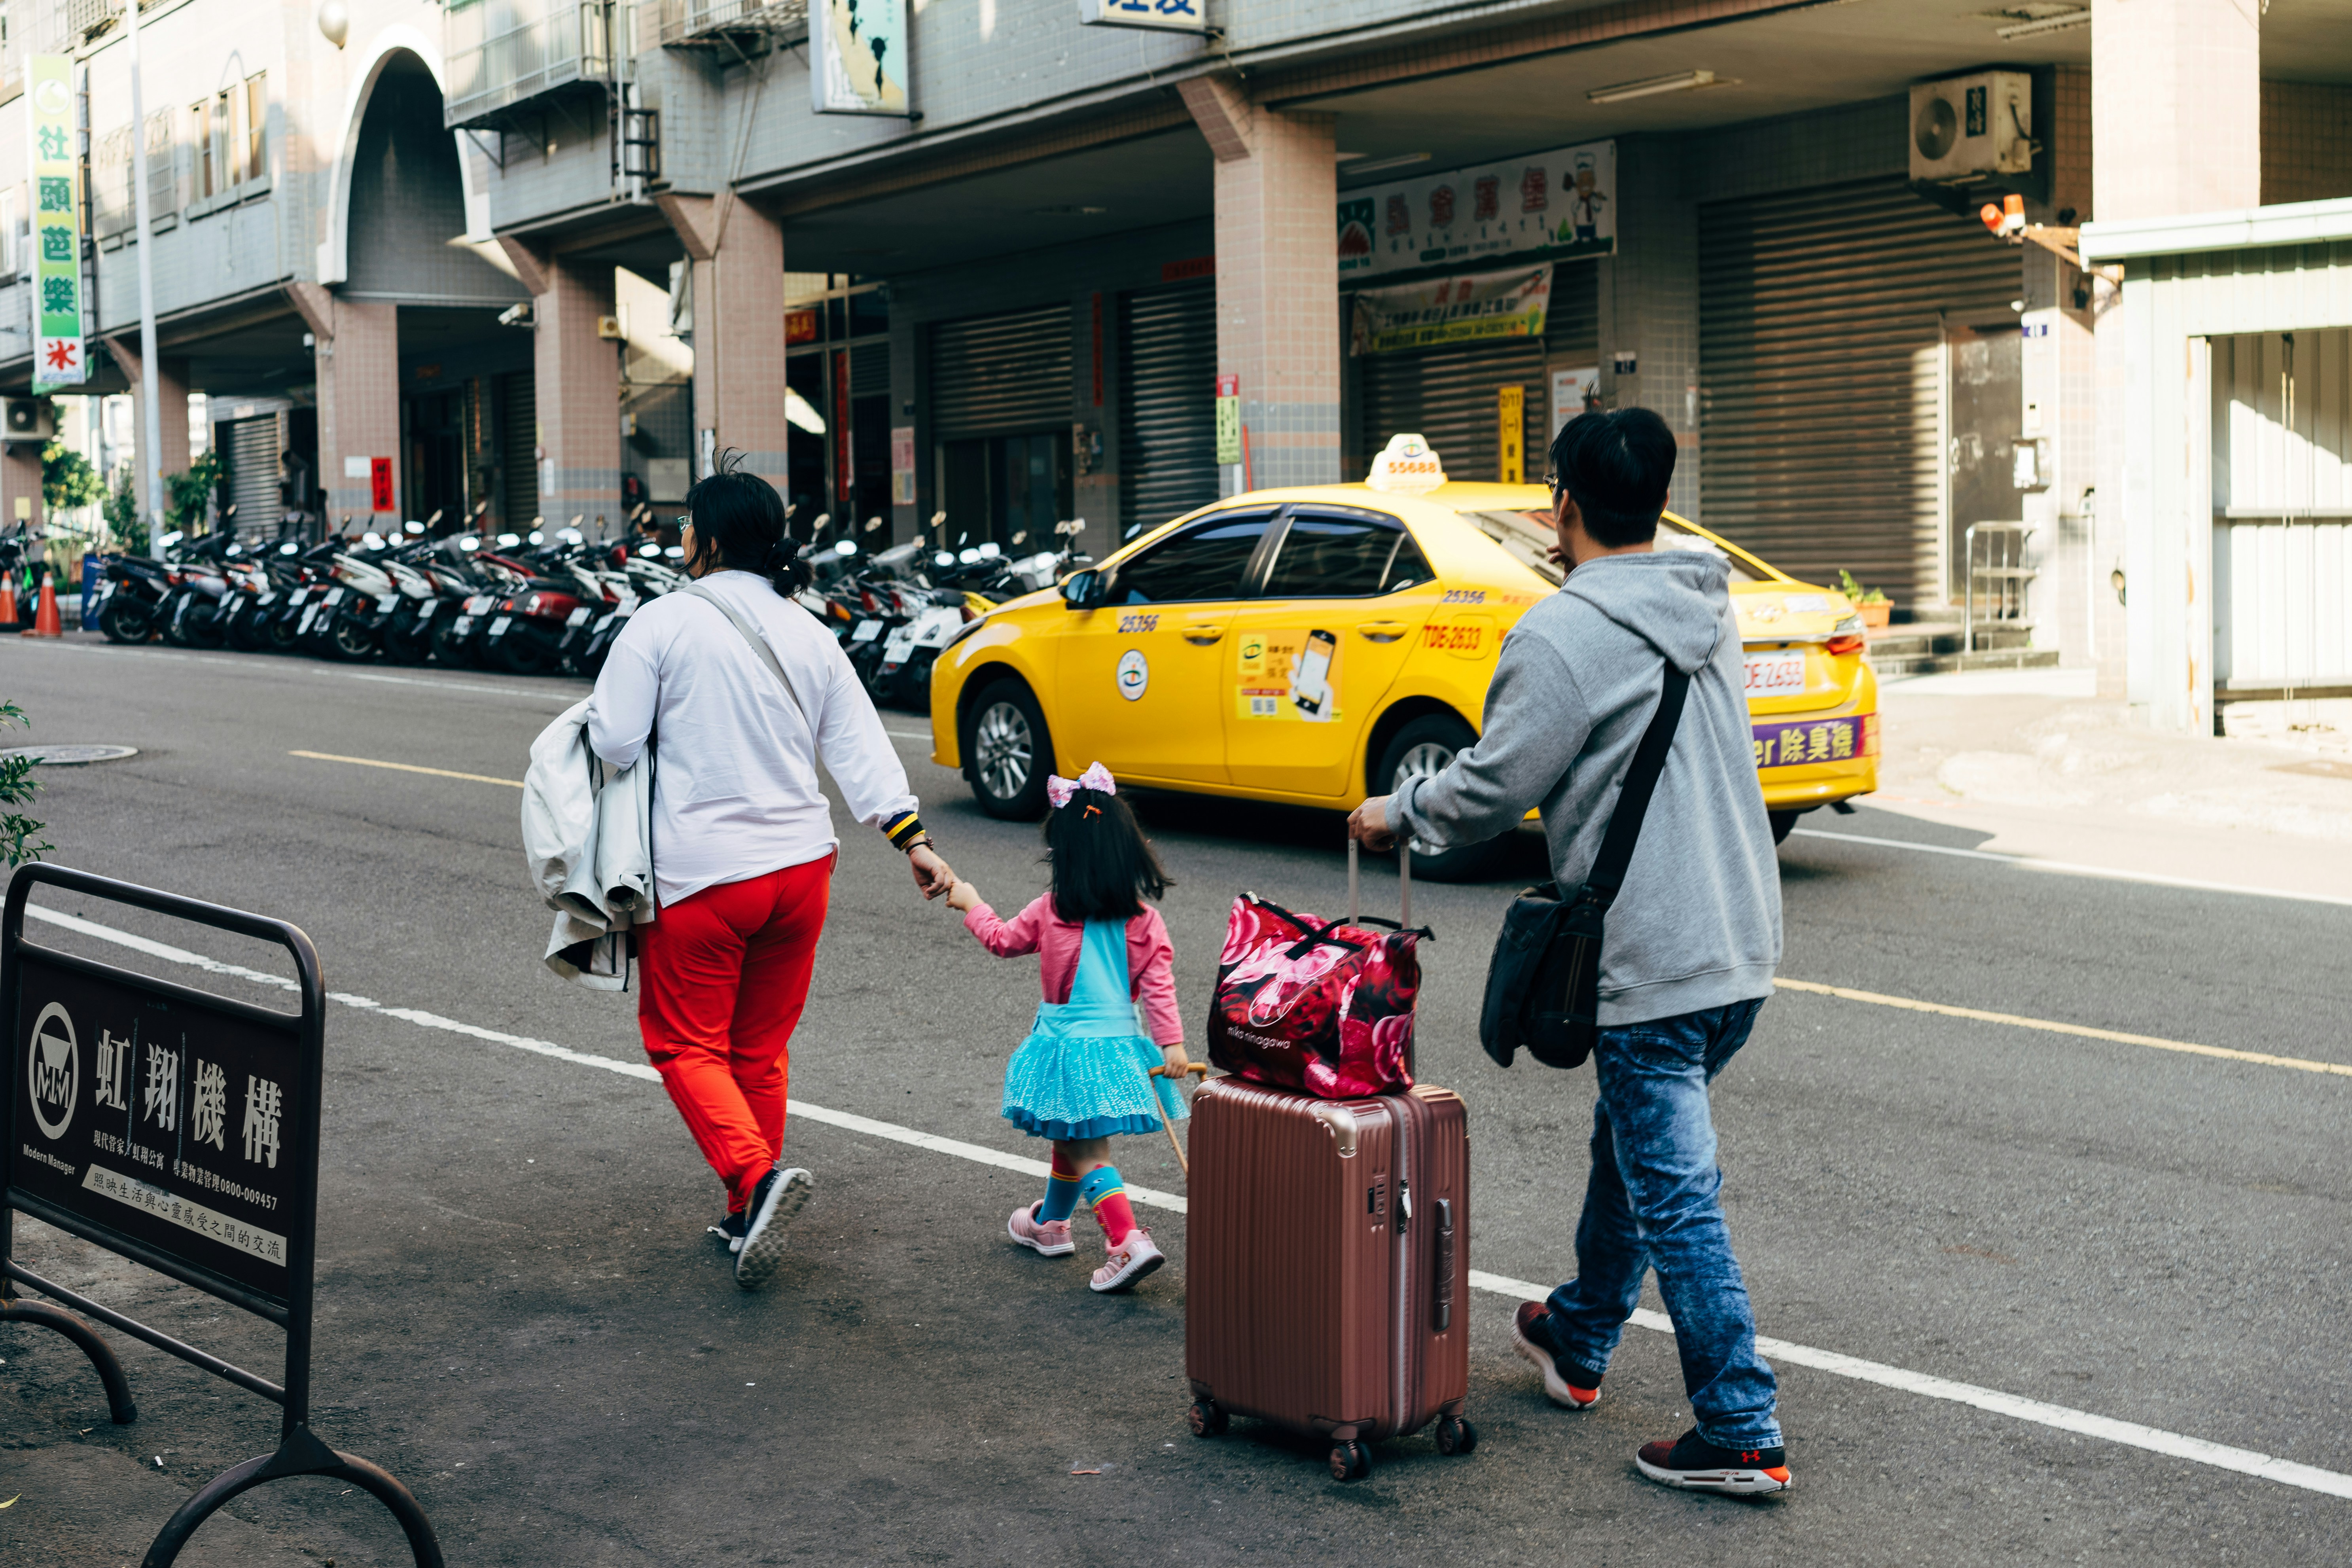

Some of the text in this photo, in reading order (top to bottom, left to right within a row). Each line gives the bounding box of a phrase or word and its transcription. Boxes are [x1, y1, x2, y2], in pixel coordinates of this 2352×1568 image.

[38, 125, 75, 312] 社頭芭樂
[1389, 462, 1437, 473] 55688
[1442, 589, 1486, 604] 25356
[1118, 615, 1159, 633] 25356
[1423, 625, 1481, 650] TDE-2633
[1227, 1025, 1244, 1039] mika
[96, 1029, 282, 1168] 虹翔機構
[23, 1144, 75, 1175] Modern Manager
[93, 1172, 281, 1259] 照映生活與心靈感受之間的交流
